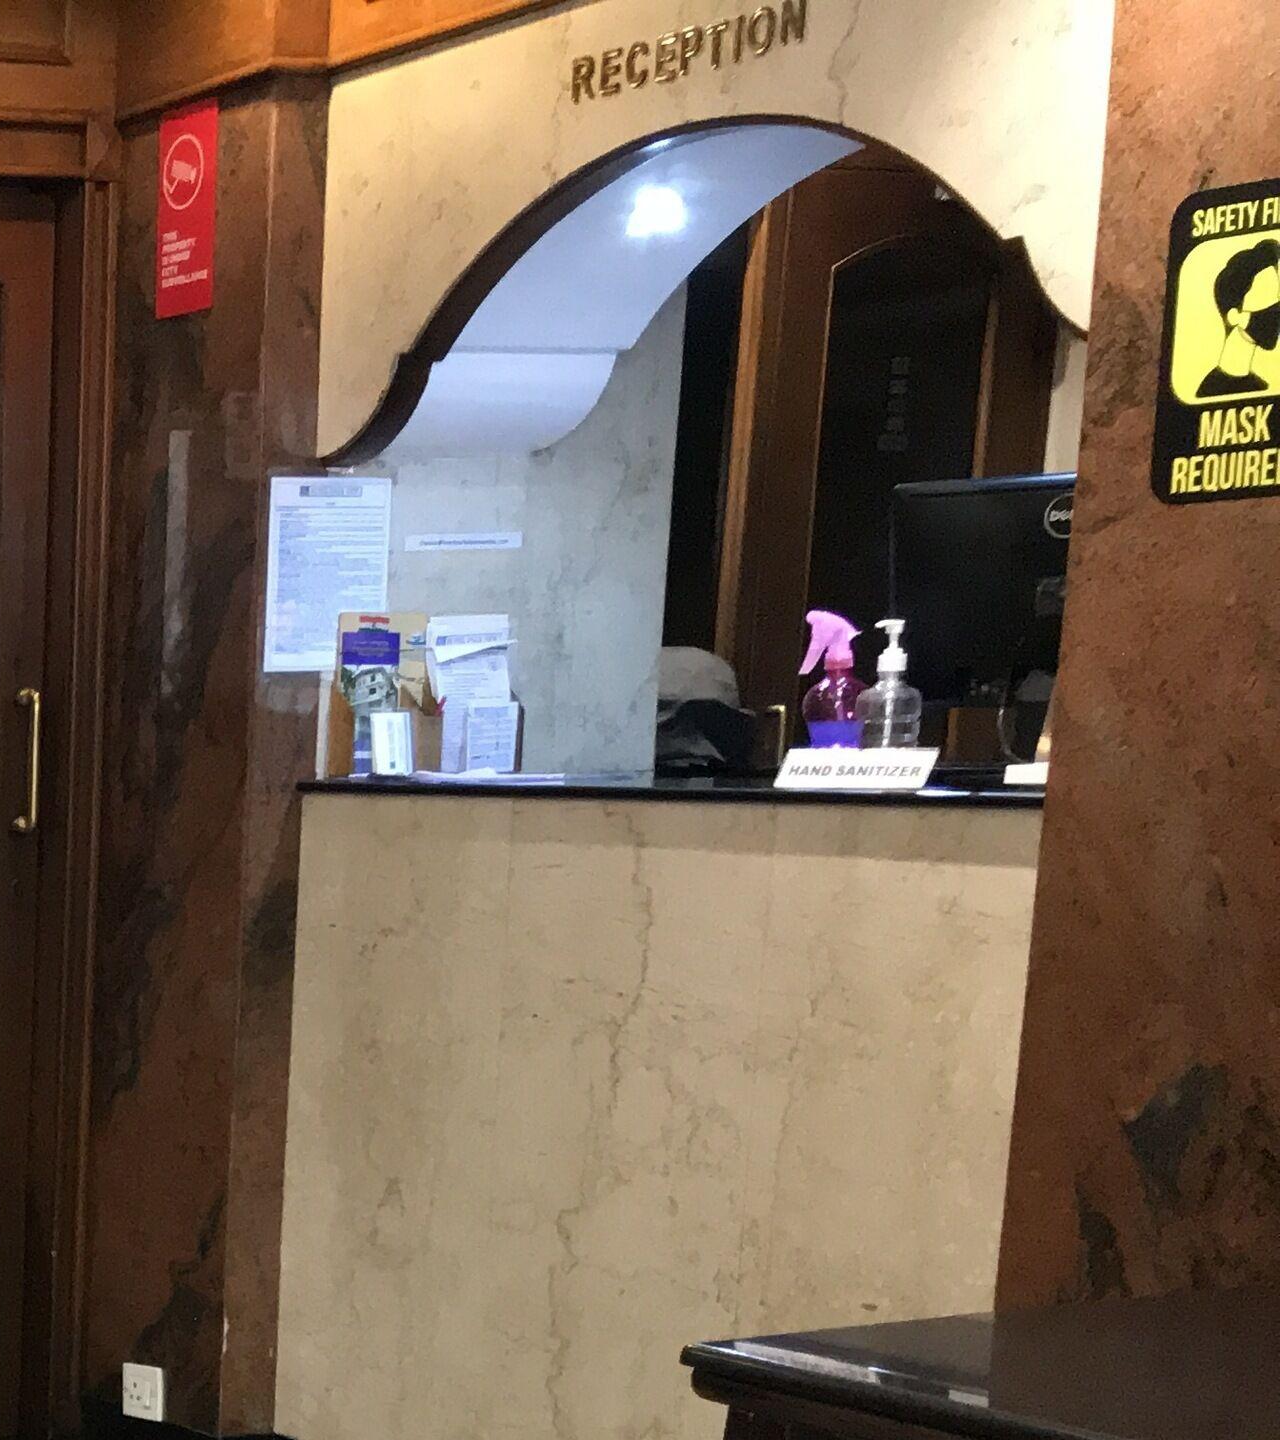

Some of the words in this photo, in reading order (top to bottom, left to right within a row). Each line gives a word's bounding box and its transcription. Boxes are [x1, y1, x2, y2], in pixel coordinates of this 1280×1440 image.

[570, 0, 807, 105] RECEPTION
[1192, 199, 1260, 237] SAFETY
[1262, 196, 1280, 226] FI
[1198, 403, 1274, 449] MASK
[788, 765, 832, 776] HAND
[835, 765, 922, 777] SANITIZER
